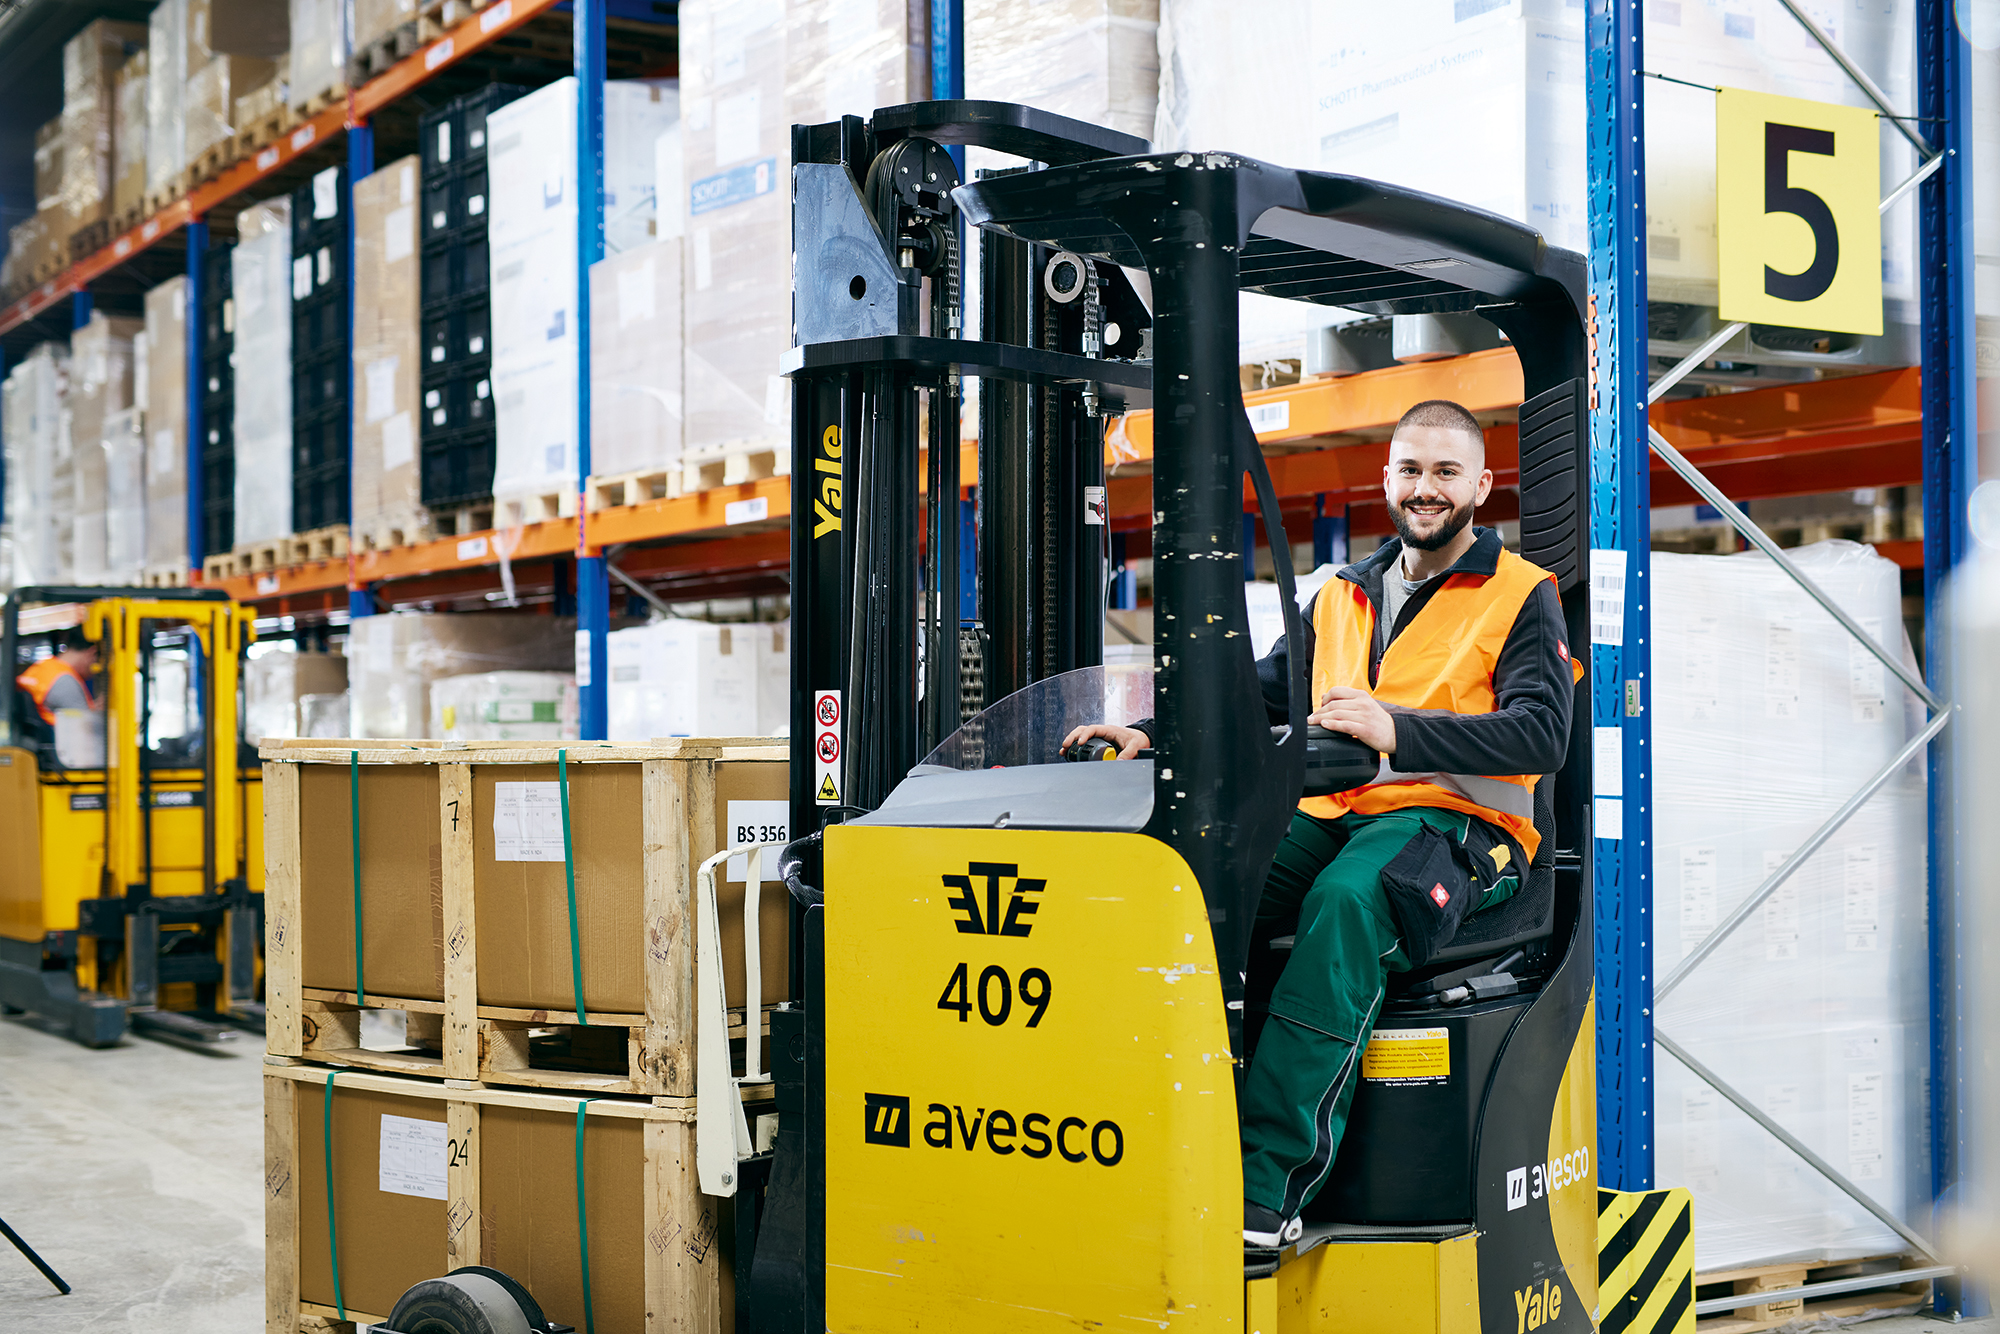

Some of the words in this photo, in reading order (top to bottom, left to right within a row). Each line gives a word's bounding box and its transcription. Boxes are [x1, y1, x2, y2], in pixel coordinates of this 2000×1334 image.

[1318, 87, 1360, 112] SCHOTT
[1361, 59, 1437, 97] Pharmaceutical
[1441, 48, 1484, 72] Systems
[1764, 122, 1840, 302] 5
[814, 424, 842, 540] Yale
[447, 800, 460, 832] 7
[737, 825, 756, 843] BS
[760, 825, 786, 843] 356
[937, 962, 1053, 1029] 409
[447, 1138, 469, 1168] 24
[923, 1102, 1125, 1167] avesco
[1531, 1145, 1589, 1200] avesco
[1514, 1278, 1562, 1334] Yale
